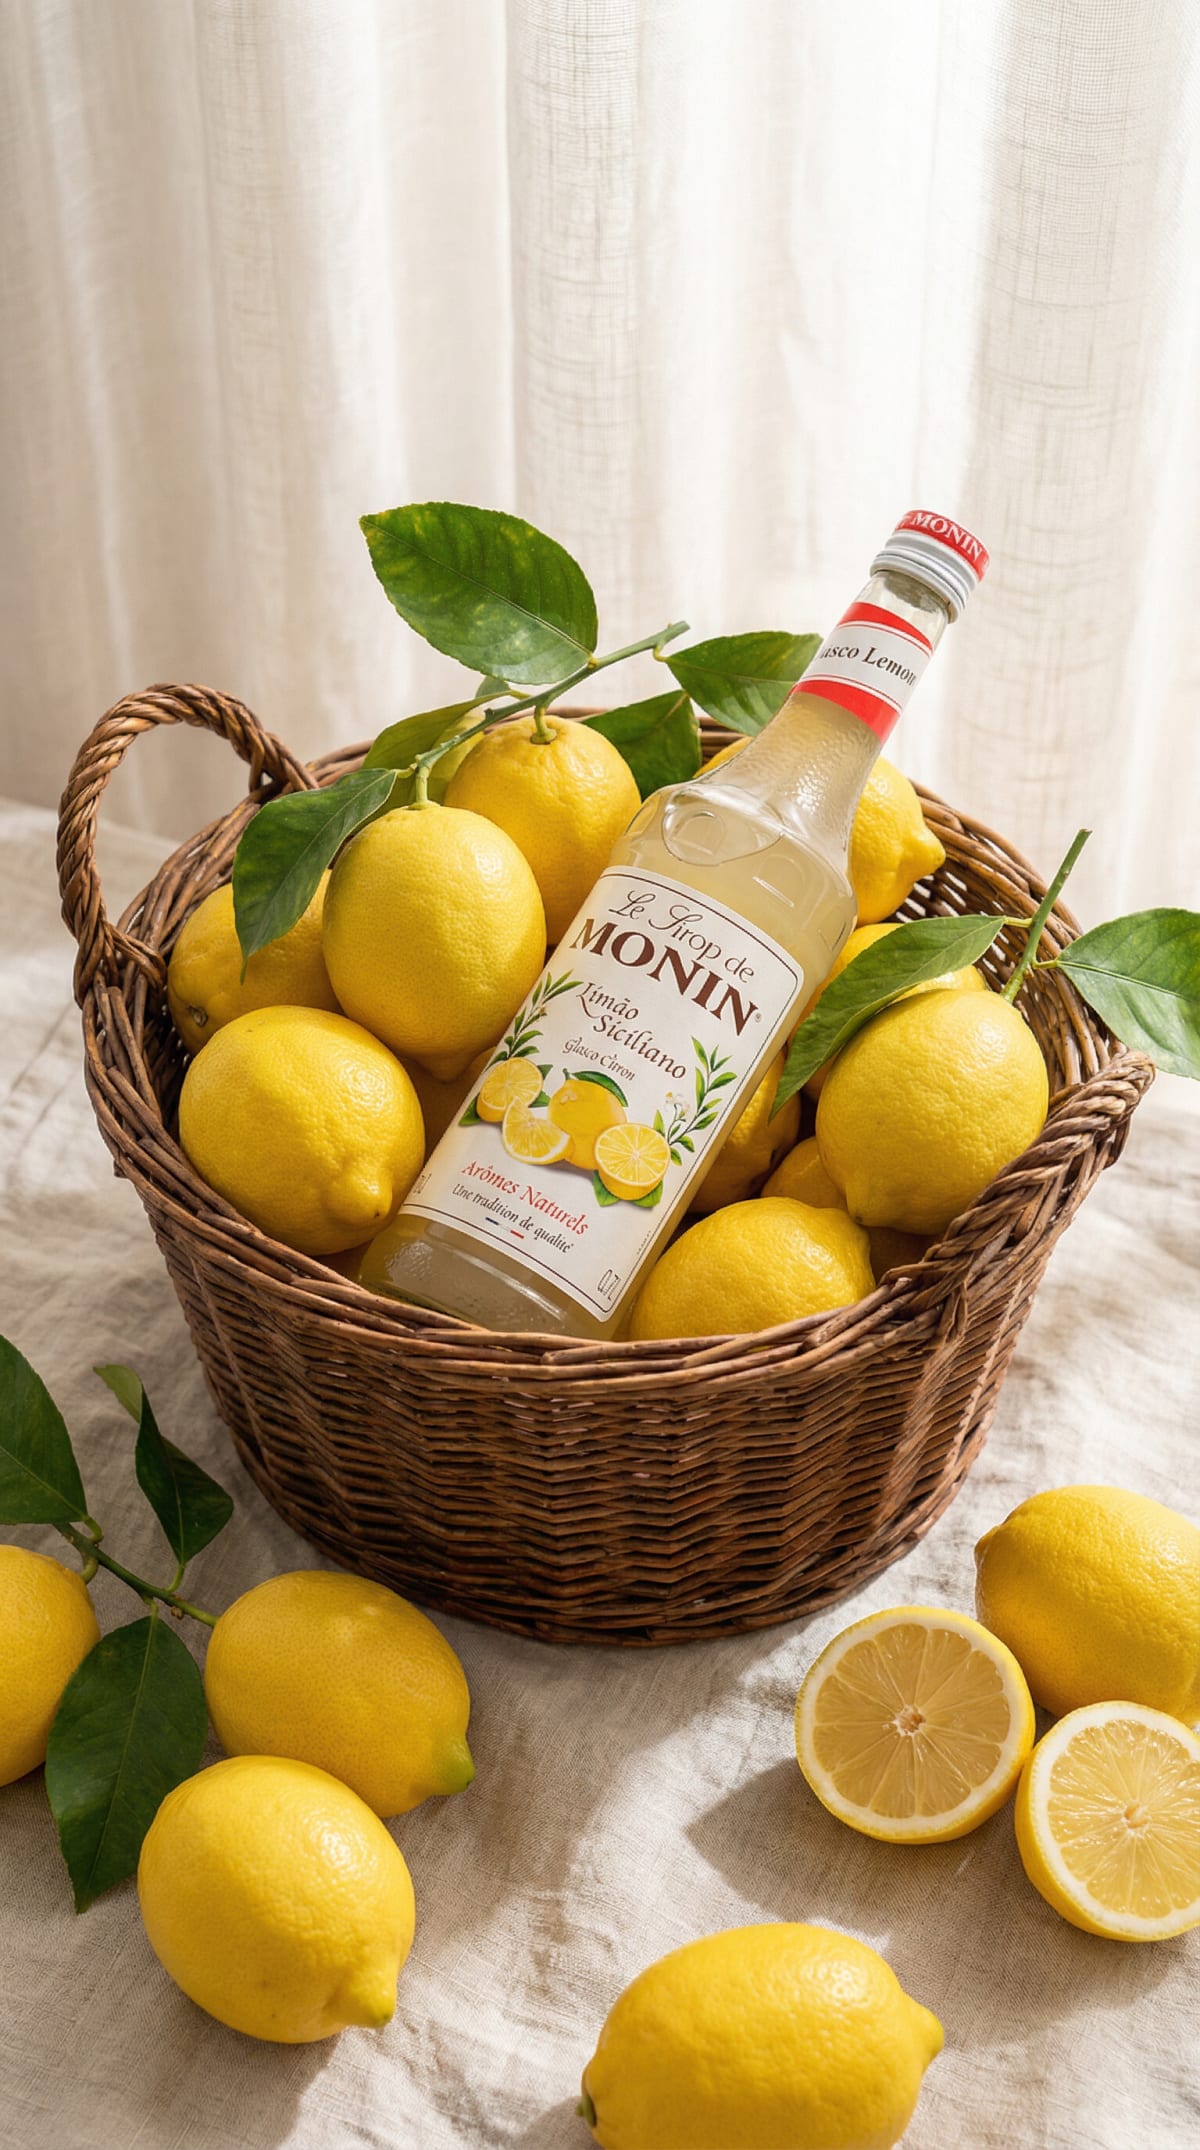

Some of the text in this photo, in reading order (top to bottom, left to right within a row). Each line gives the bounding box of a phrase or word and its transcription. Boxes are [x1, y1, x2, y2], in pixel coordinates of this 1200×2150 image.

[910, 512, 982, 562] MONIN
[608, 890, 755, 984] Le Sirop de
[569, 918, 759, 1037] MONIN
[575, 982, 639, 1020] Limão
[593, 1014, 687, 1079] Siciliano
[452, 1183, 473, 1200] Une
[472, 1197, 519, 1223] tradition
[519, 1216, 534, 1231] de
[461, 1160, 520, 1194] Arômes
[520, 1185, 588, 1235] Naturels
